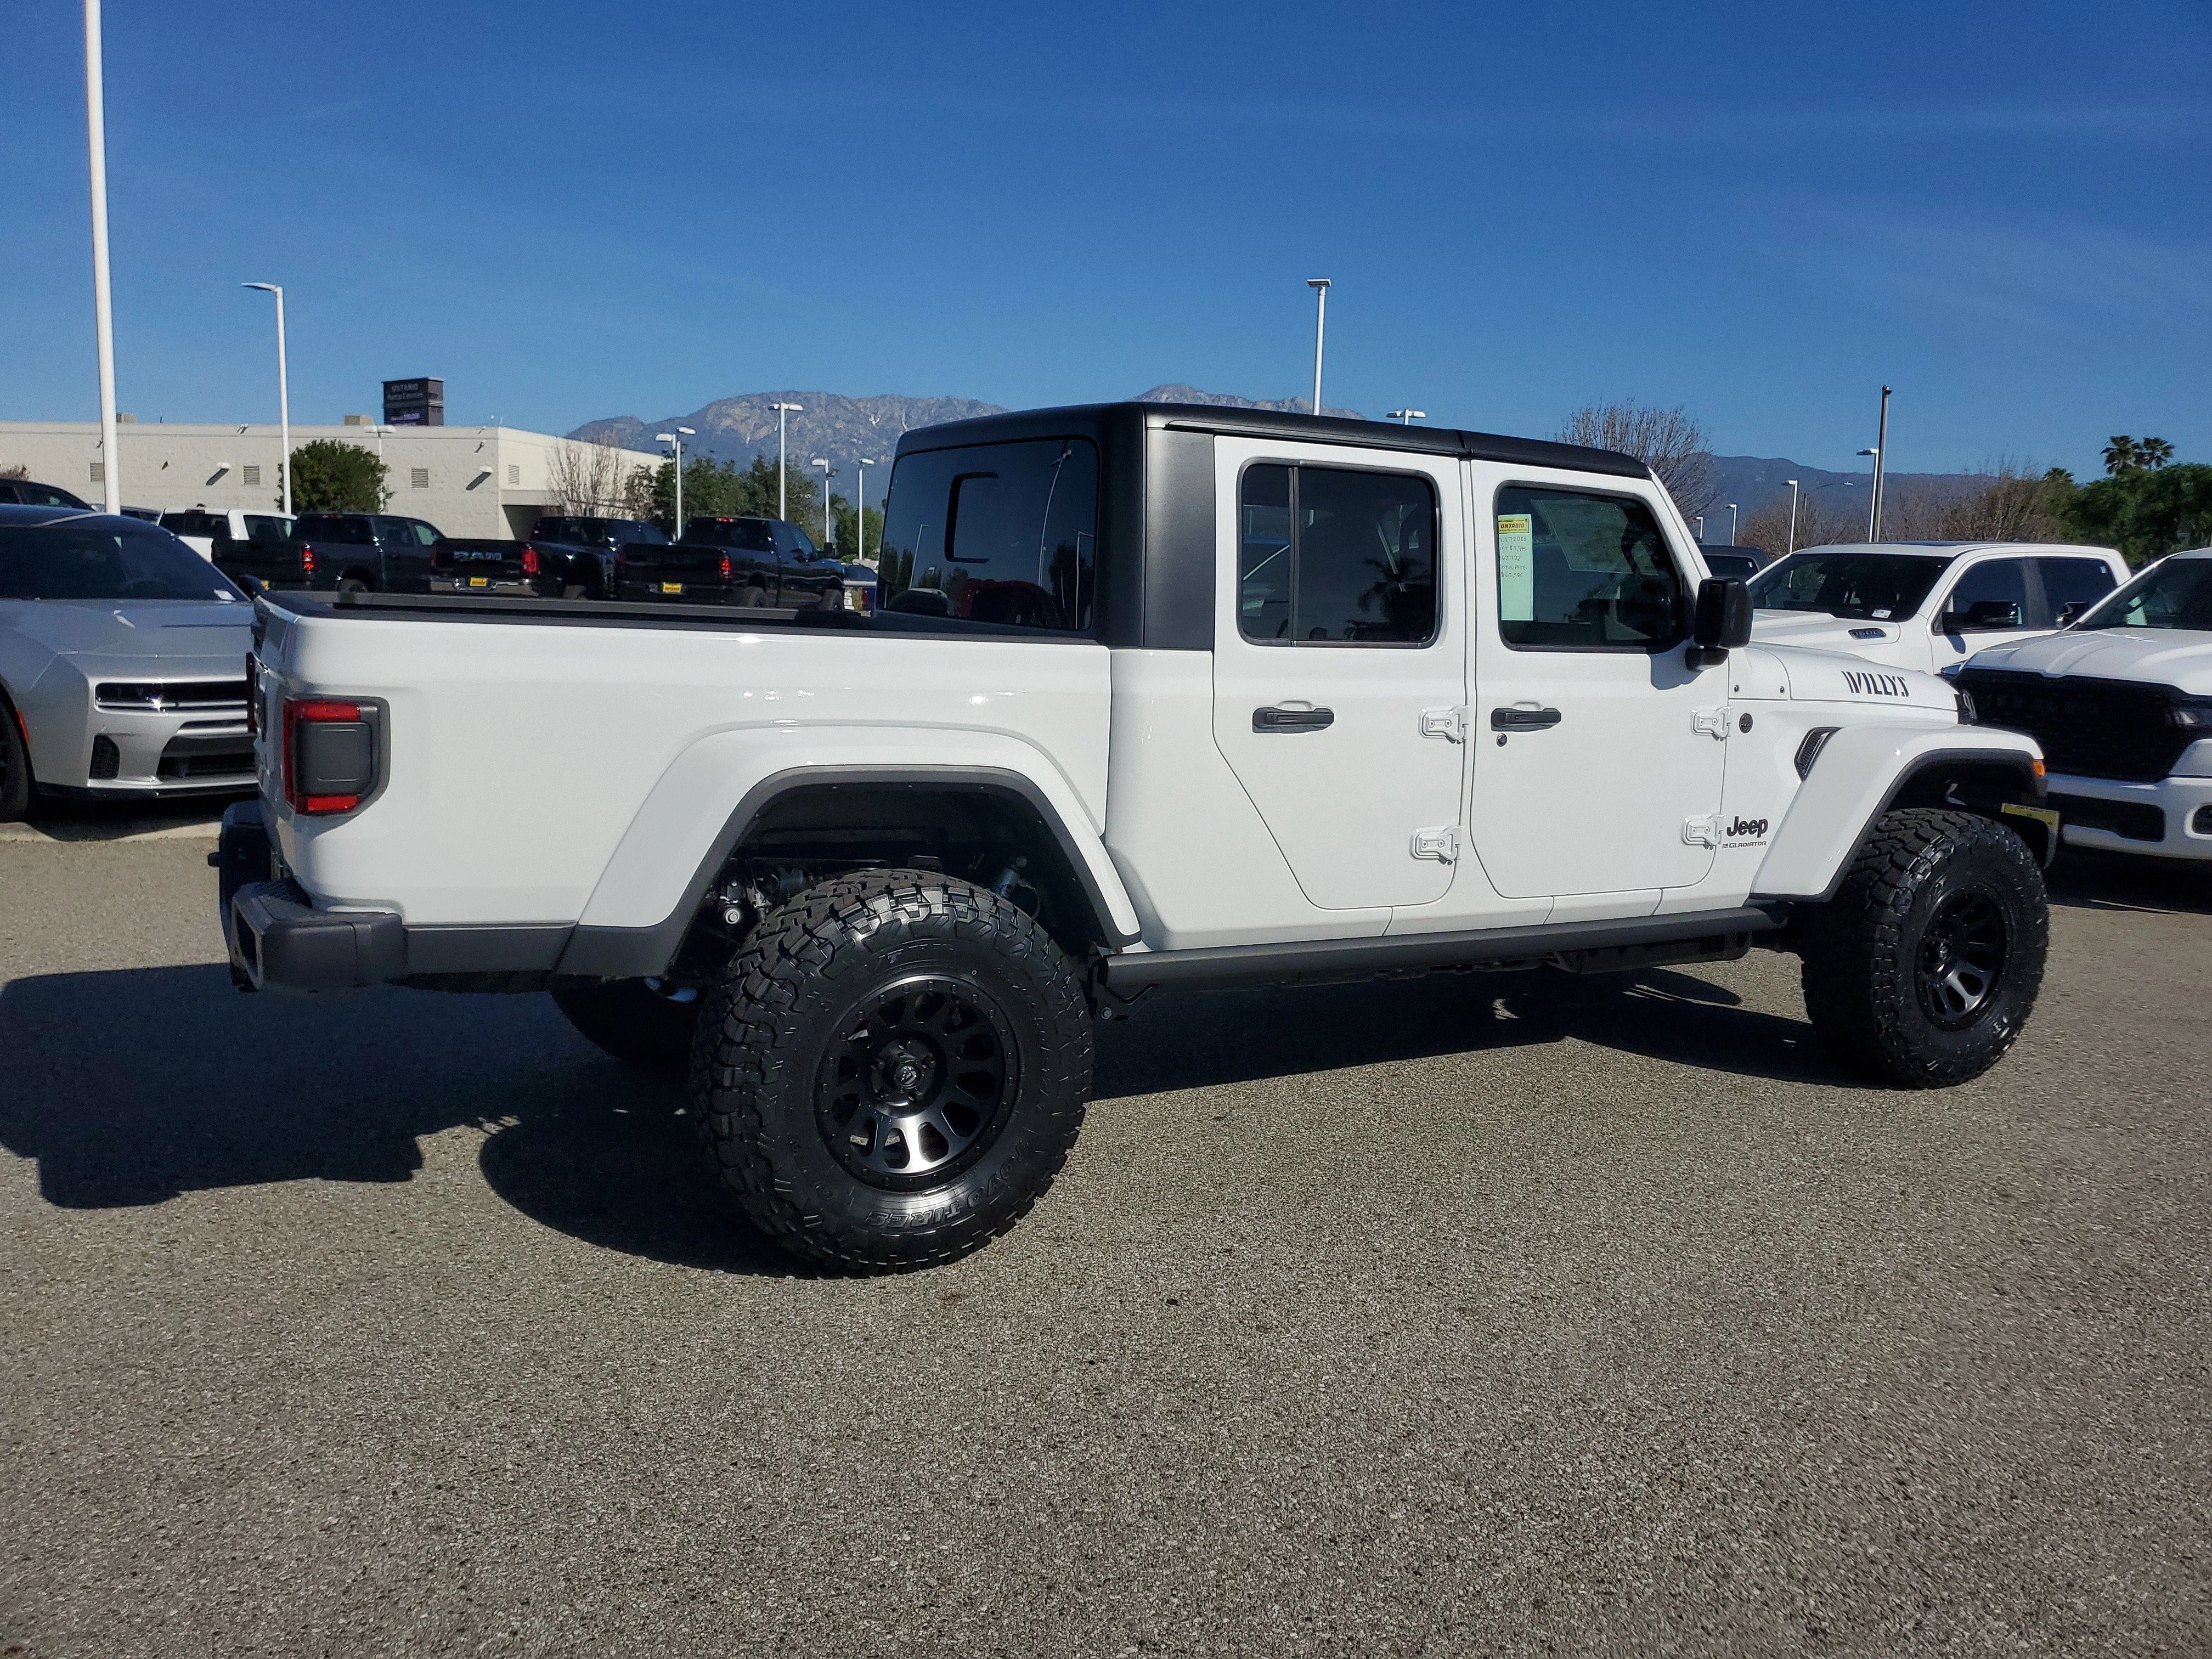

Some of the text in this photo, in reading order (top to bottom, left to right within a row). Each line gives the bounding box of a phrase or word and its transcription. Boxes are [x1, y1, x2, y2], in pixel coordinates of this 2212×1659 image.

[1840, 670, 1909, 697] WILLYS
[1726, 816, 1769, 838] Jeep
[865, 1199, 962, 1228] TIRES
